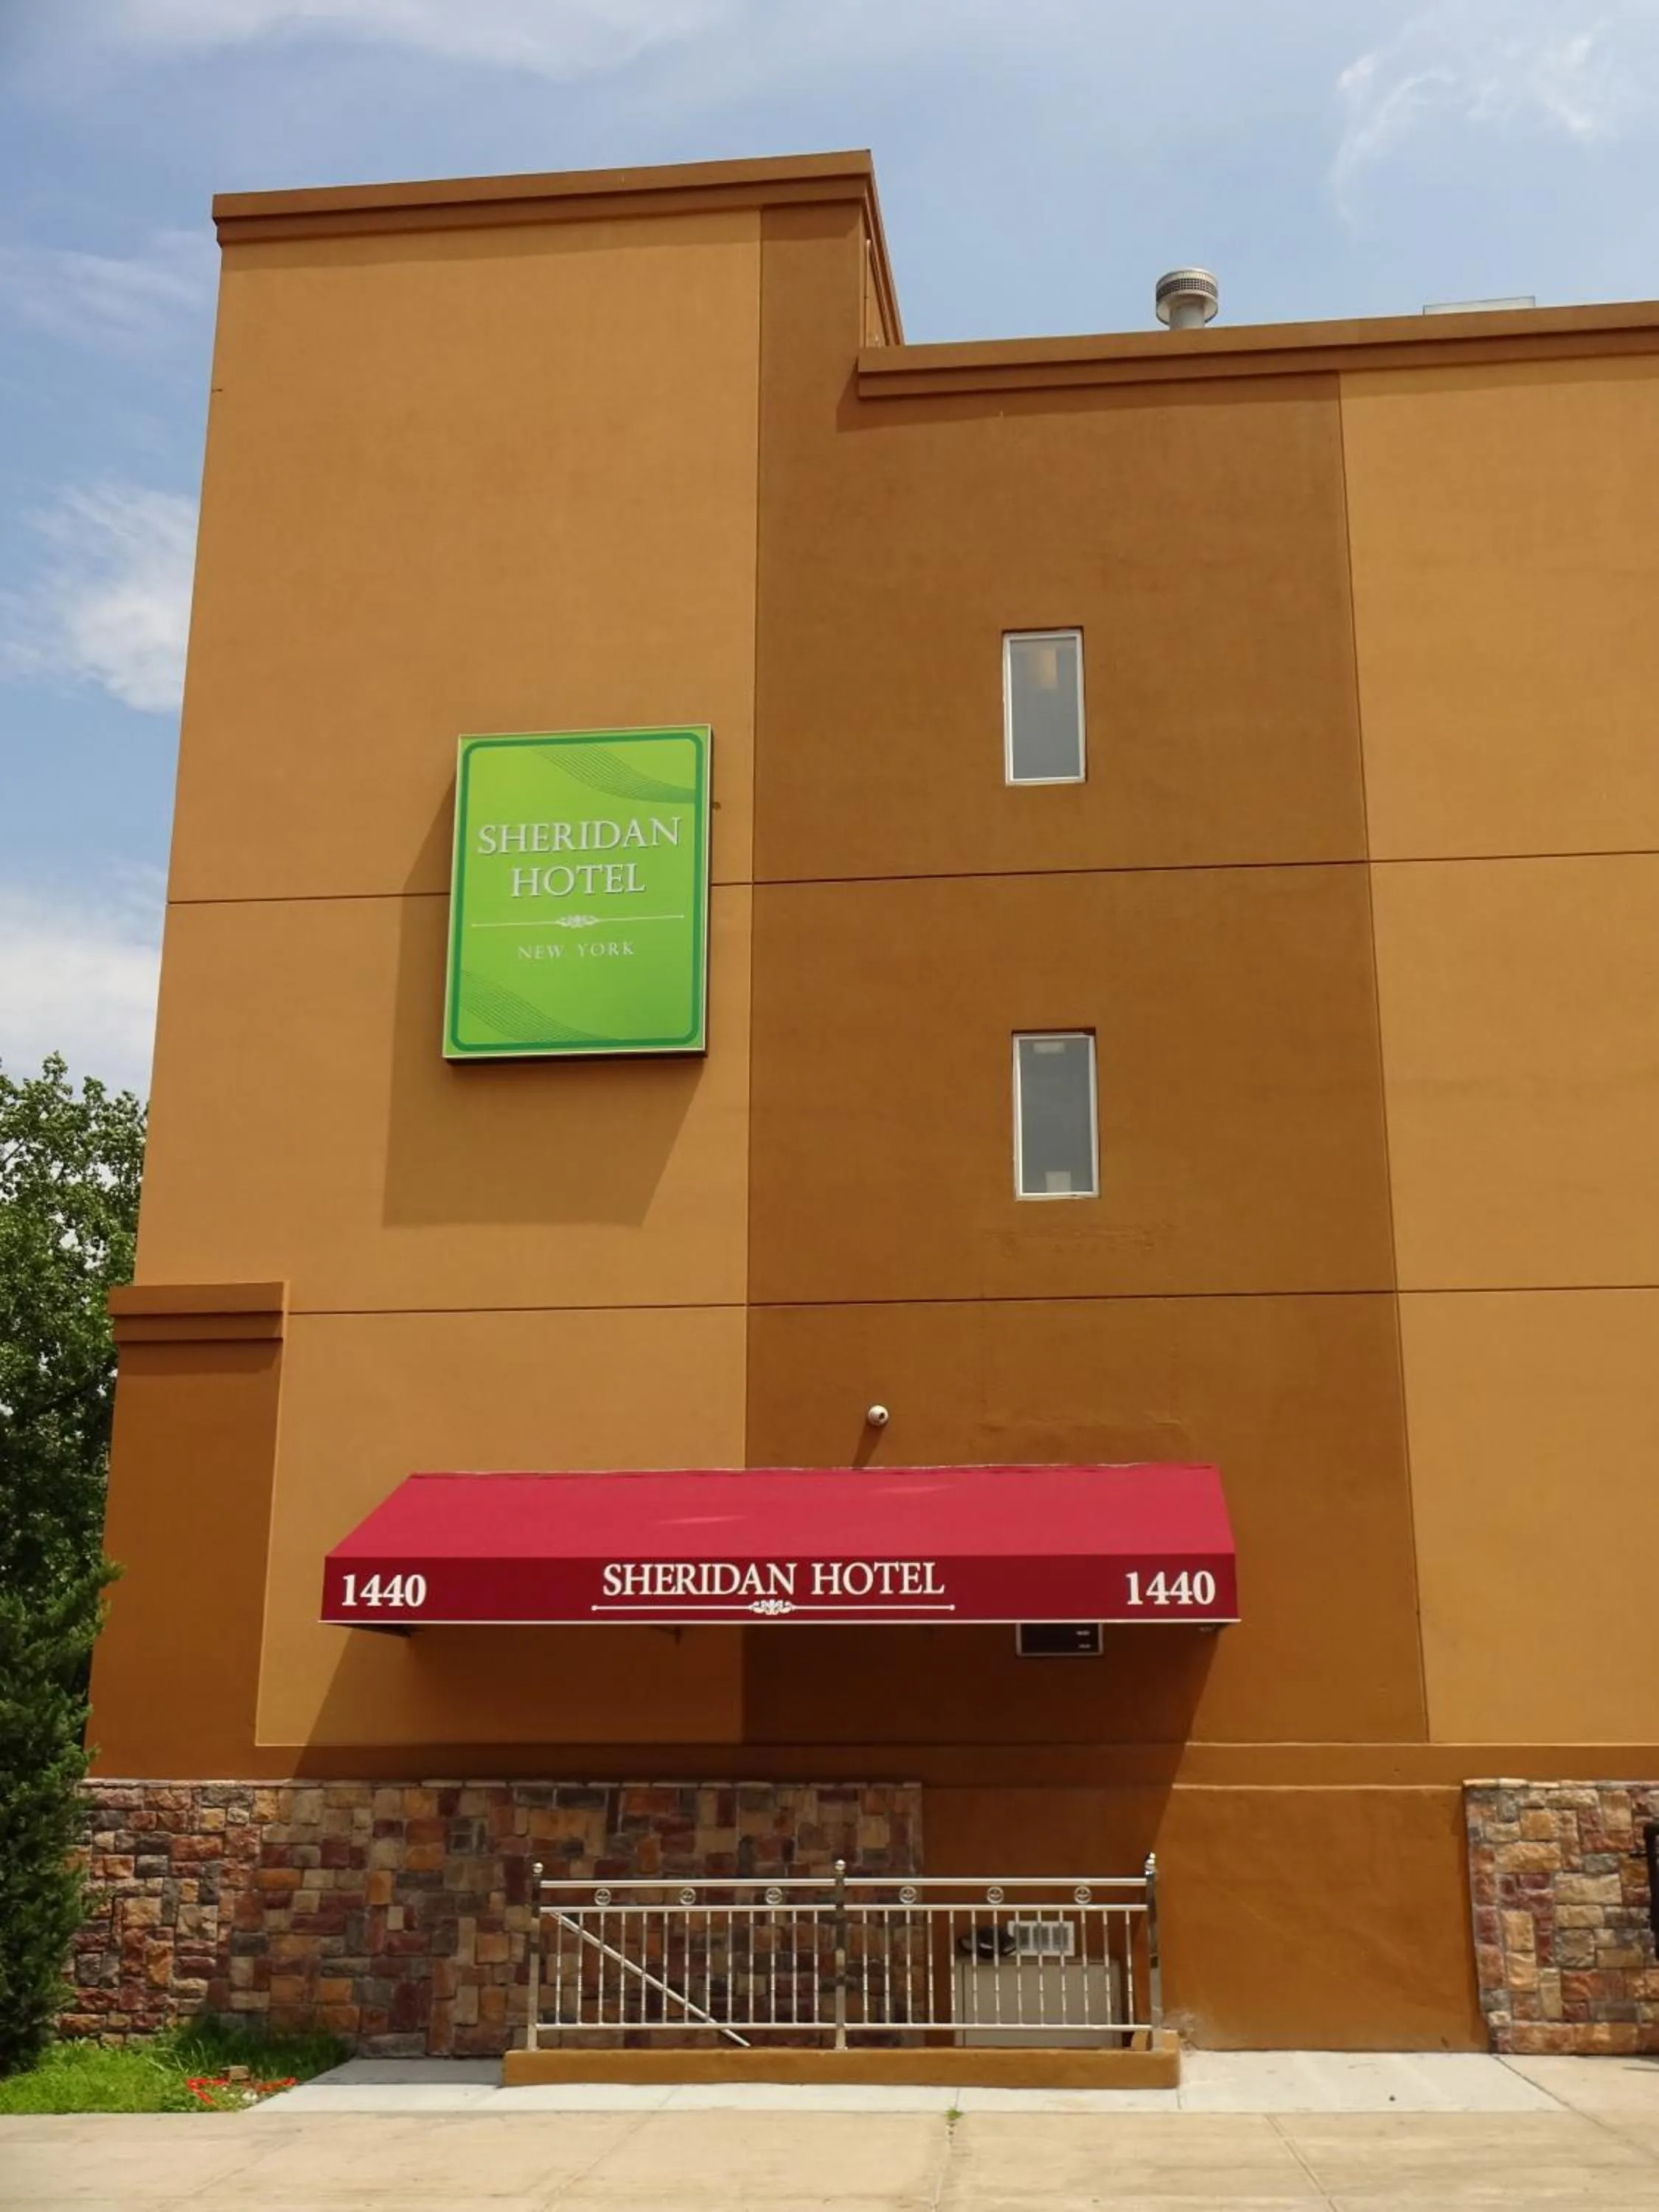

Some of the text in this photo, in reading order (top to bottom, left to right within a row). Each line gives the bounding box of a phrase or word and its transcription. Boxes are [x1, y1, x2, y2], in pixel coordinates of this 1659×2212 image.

[477, 817, 683, 855] SHERIDAN
[510, 863, 646, 898] HOTEL
[518, 941, 635, 960] NEW YORK
[341, 1573, 427, 1607] 1440
[602, 1562, 945, 1596] SHERIDAN HOTEL
[1125, 1570, 1216, 1605] 1440
